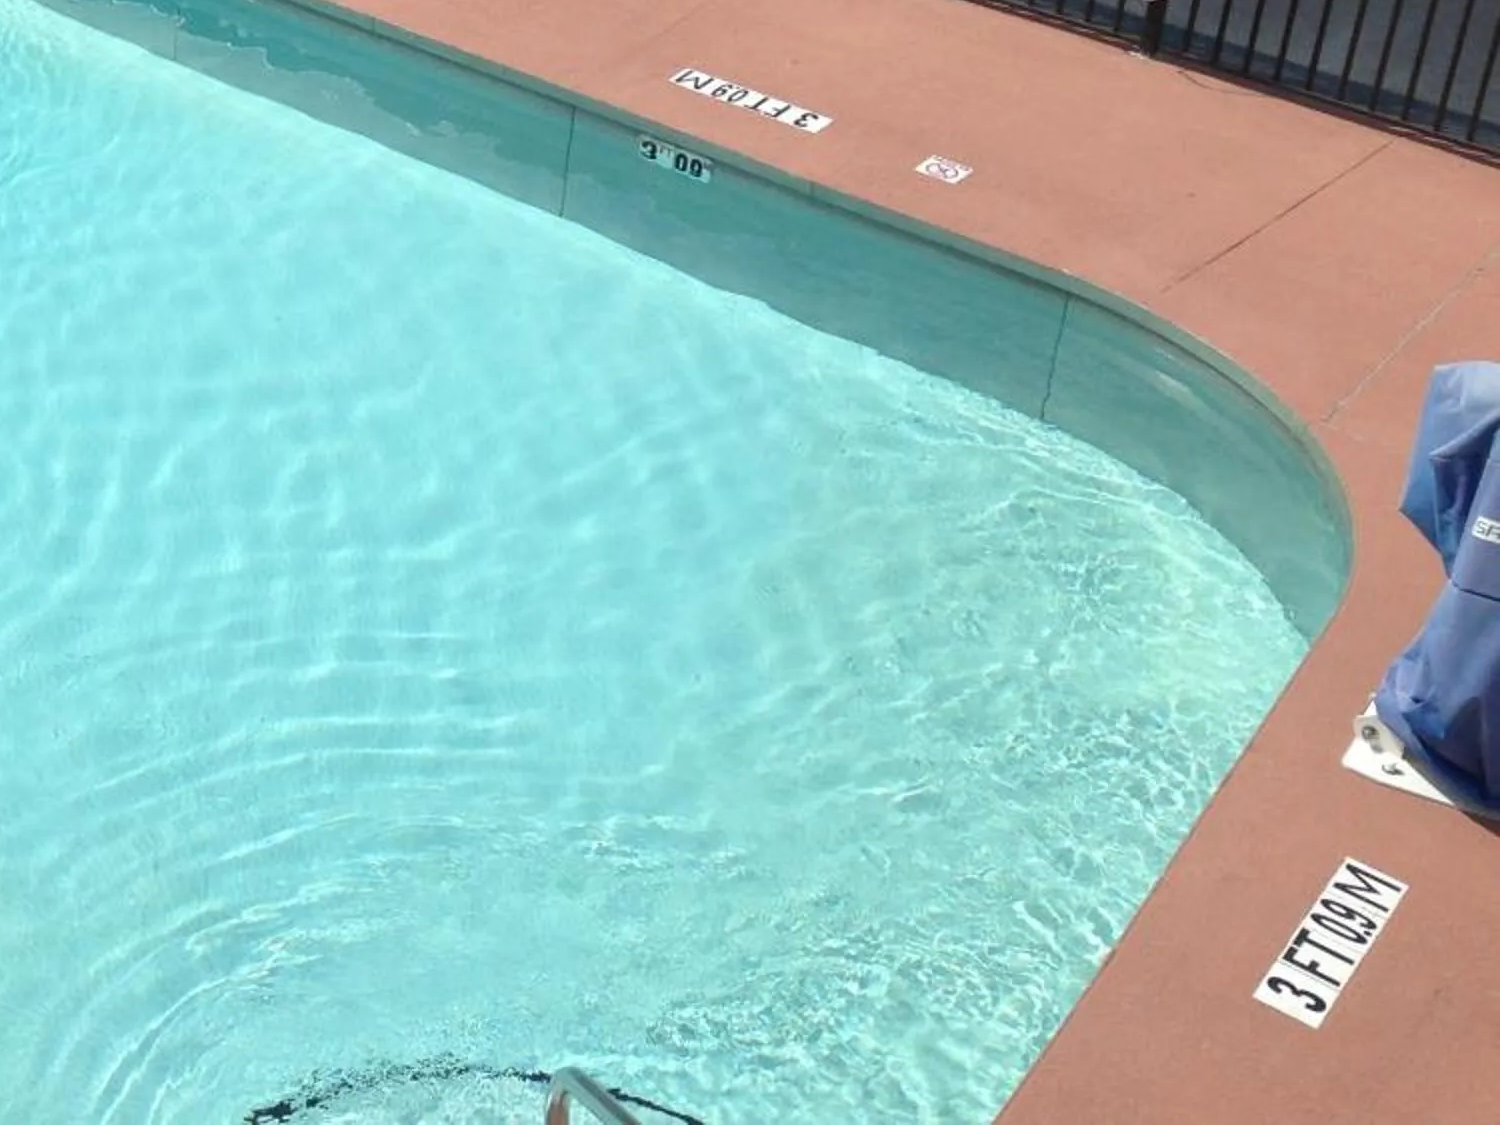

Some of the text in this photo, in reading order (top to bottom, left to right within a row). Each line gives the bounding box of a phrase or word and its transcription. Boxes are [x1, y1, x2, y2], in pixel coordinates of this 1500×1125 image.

[675, 70, 715, 90] M
[794, 112, 819, 128] 3
[641, 141, 657, 160] 3
[1333, 863, 1401, 912] M
[1282, 927, 1355, 987] FT
[1267, 976, 1327, 1013] 3
